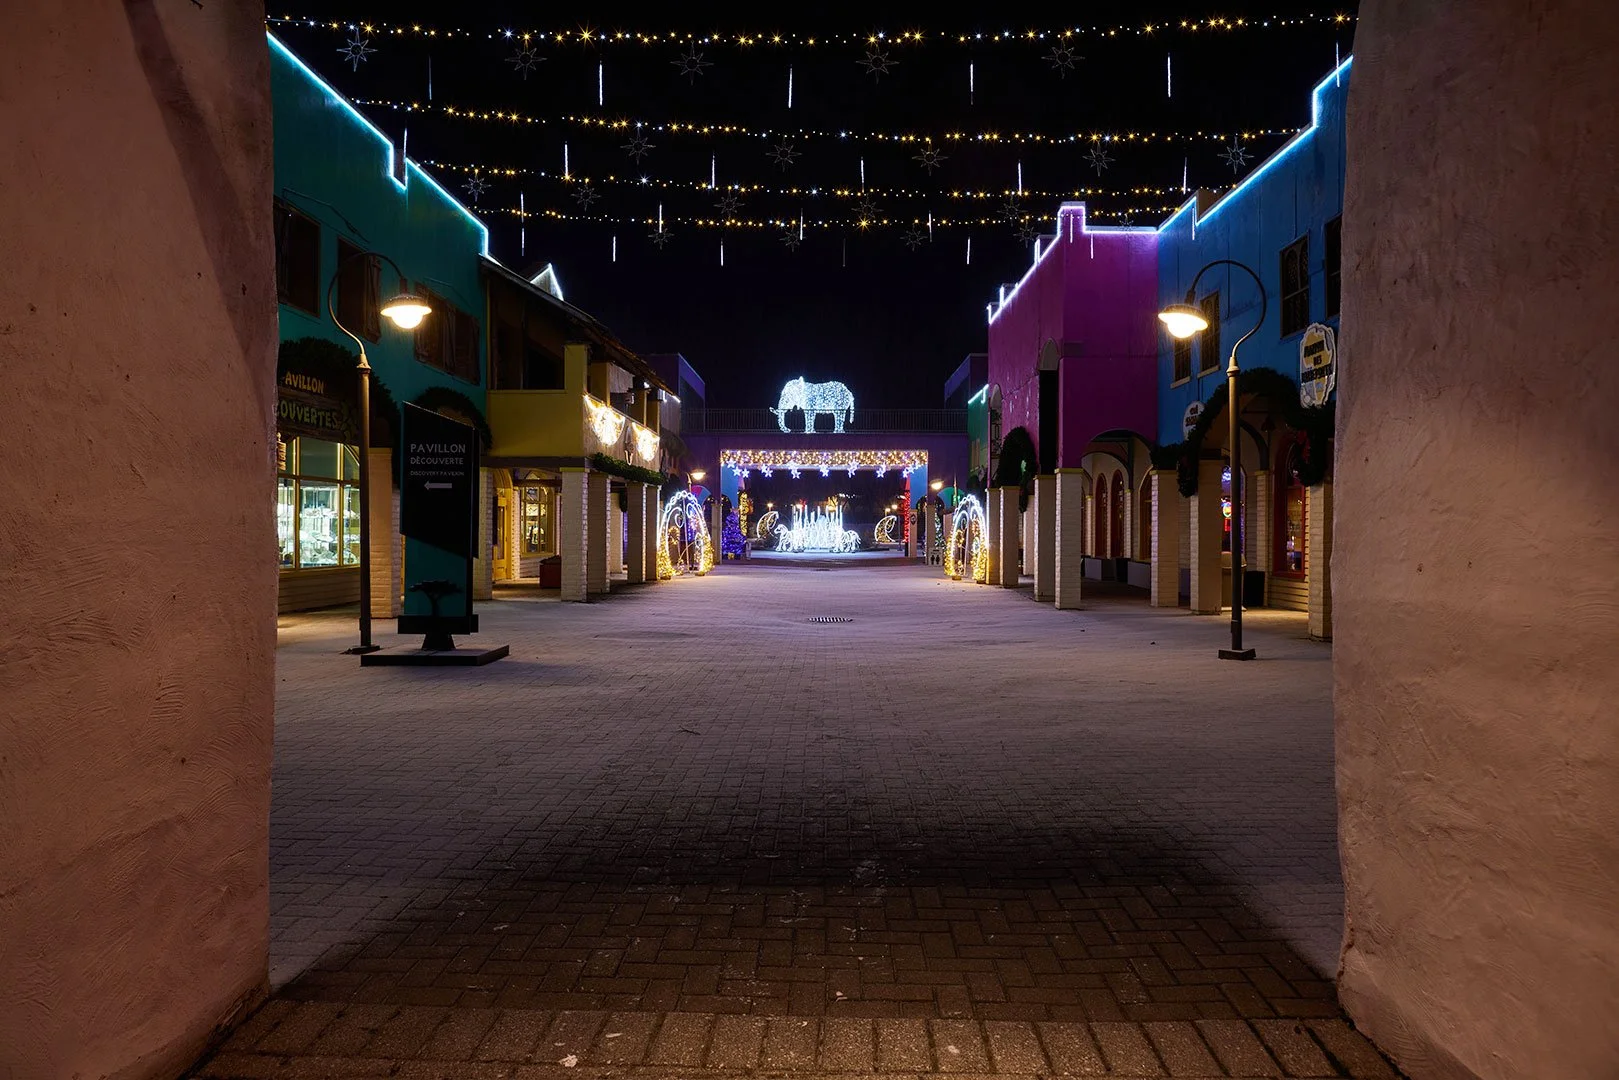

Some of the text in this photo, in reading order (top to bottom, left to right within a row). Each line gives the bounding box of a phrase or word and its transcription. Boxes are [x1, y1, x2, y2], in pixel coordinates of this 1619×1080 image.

[284, 370, 324, 394] AVILLON
[279, 399, 338, 430] OUVERTES
[410, 443, 466, 454] PAVILLON
